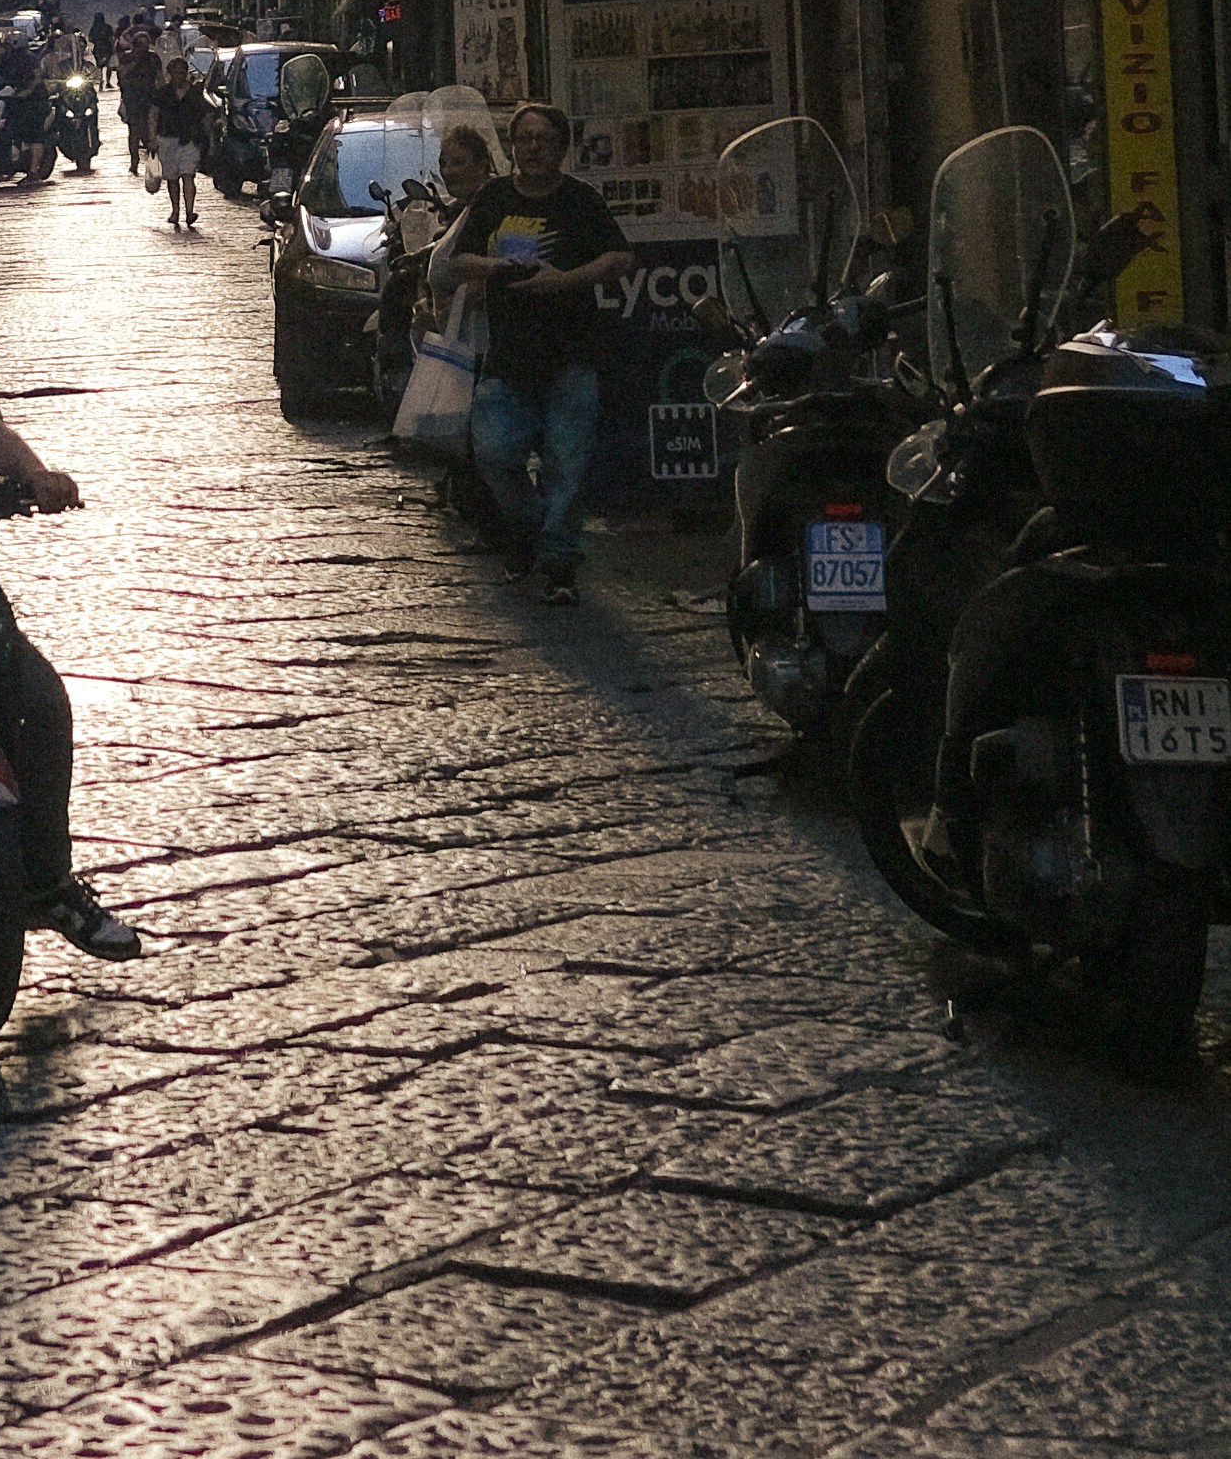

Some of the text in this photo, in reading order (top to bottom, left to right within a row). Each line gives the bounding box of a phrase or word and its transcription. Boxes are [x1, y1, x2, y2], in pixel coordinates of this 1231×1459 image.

[650, 311, 697, 331] Mob
[666, 436, 702, 451] eSIM
[826, 526, 855, 552] FS
[813, 560, 880, 587] 87057
[1139, 726, 1227, 754] 16T5
